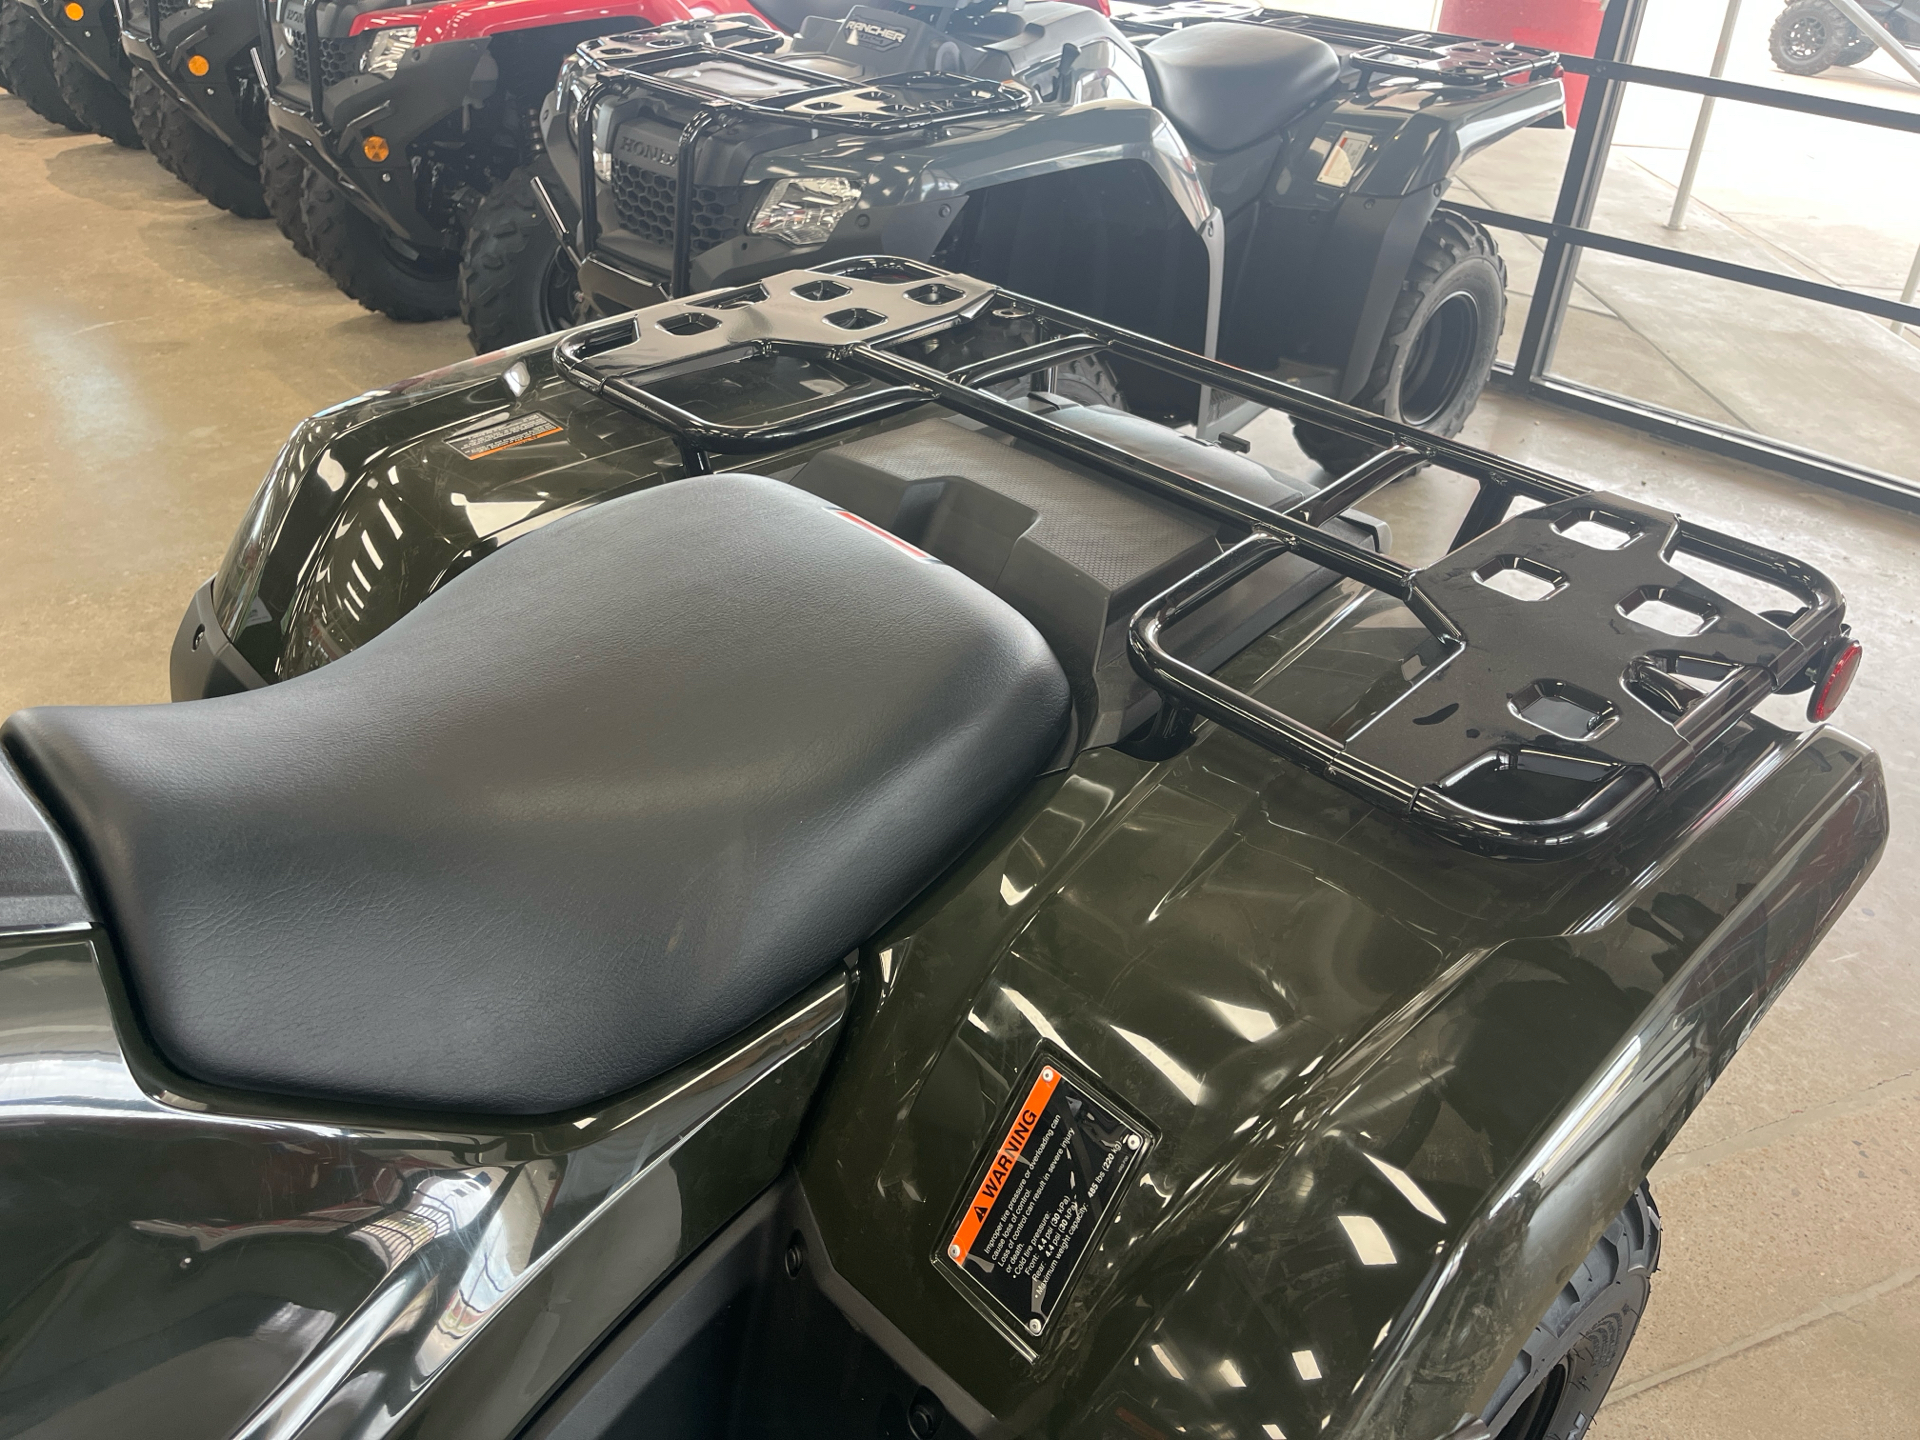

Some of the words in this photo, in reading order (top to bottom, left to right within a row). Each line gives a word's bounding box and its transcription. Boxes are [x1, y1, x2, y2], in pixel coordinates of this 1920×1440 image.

[845, 20, 906, 42] RANCHER
[1050, 1114, 1061, 1129] can
[981, 1109, 1037, 1198] WARNING
[1027, 1128, 1054, 1170] overloading
[1007, 1178, 1026, 1211] pressure
[1024, 1169, 1031, 1179] or
[997, 1248, 1010, 1267] Loss
[1008, 1239, 1014, 1249] of
[1012, 1214, 1028, 1241] control
[1025, 1201, 1035, 1216] can
[1032, 1180, 1046, 1202] result
[1042, 1172, 1050, 1181] in
[1048, 1148, 1064, 1173] severe
[1060, 1127, 1075, 1150] injury
[1000, 1209, 1010, 1222] tire
[983, 1221, 1003, 1254] Improper
[991, 1238, 1005, 1261] cause
[1001, 1223, 1013, 1238] loss
[1011, 1213, 1018, 1223] of
[1015, 1188, 1031, 1215] control.
[1024, 1253, 1039, 1275] Front:
[1037, 1237, 1047, 1251] 4.4
[1044, 1226, 1053, 1240] psi
[1050, 1212, 1060, 1227] (30
[1056, 1195, 1070, 1214] kPa)
[1035, 1259, 1058, 1297] Maximum
[1055, 1234, 1071, 1259] weight
[1068, 1202, 1088, 1235] capacity:
[1087, 1182, 1098, 1198] 485
[1094, 1170, 1105, 1184] lbs
[1101, 1152, 1115, 1172] (220
[1110, 1140, 1122, 1154] kg)
[1005, 1263, 1012, 1273] or
[1010, 1243, 1025, 1264] death.
[1014, 1256, 1027, 1275] Cold
[1023, 1245, 1033, 1258] tire
[1030, 1211, 1050, 1246] pressure:
[1031, 1260, 1045, 1284] Rear:
[1045, 1244, 1055, 1257] 4.4
[1052, 1232, 1061, 1246] psi
[1057, 1218, 1068, 1233] (30
